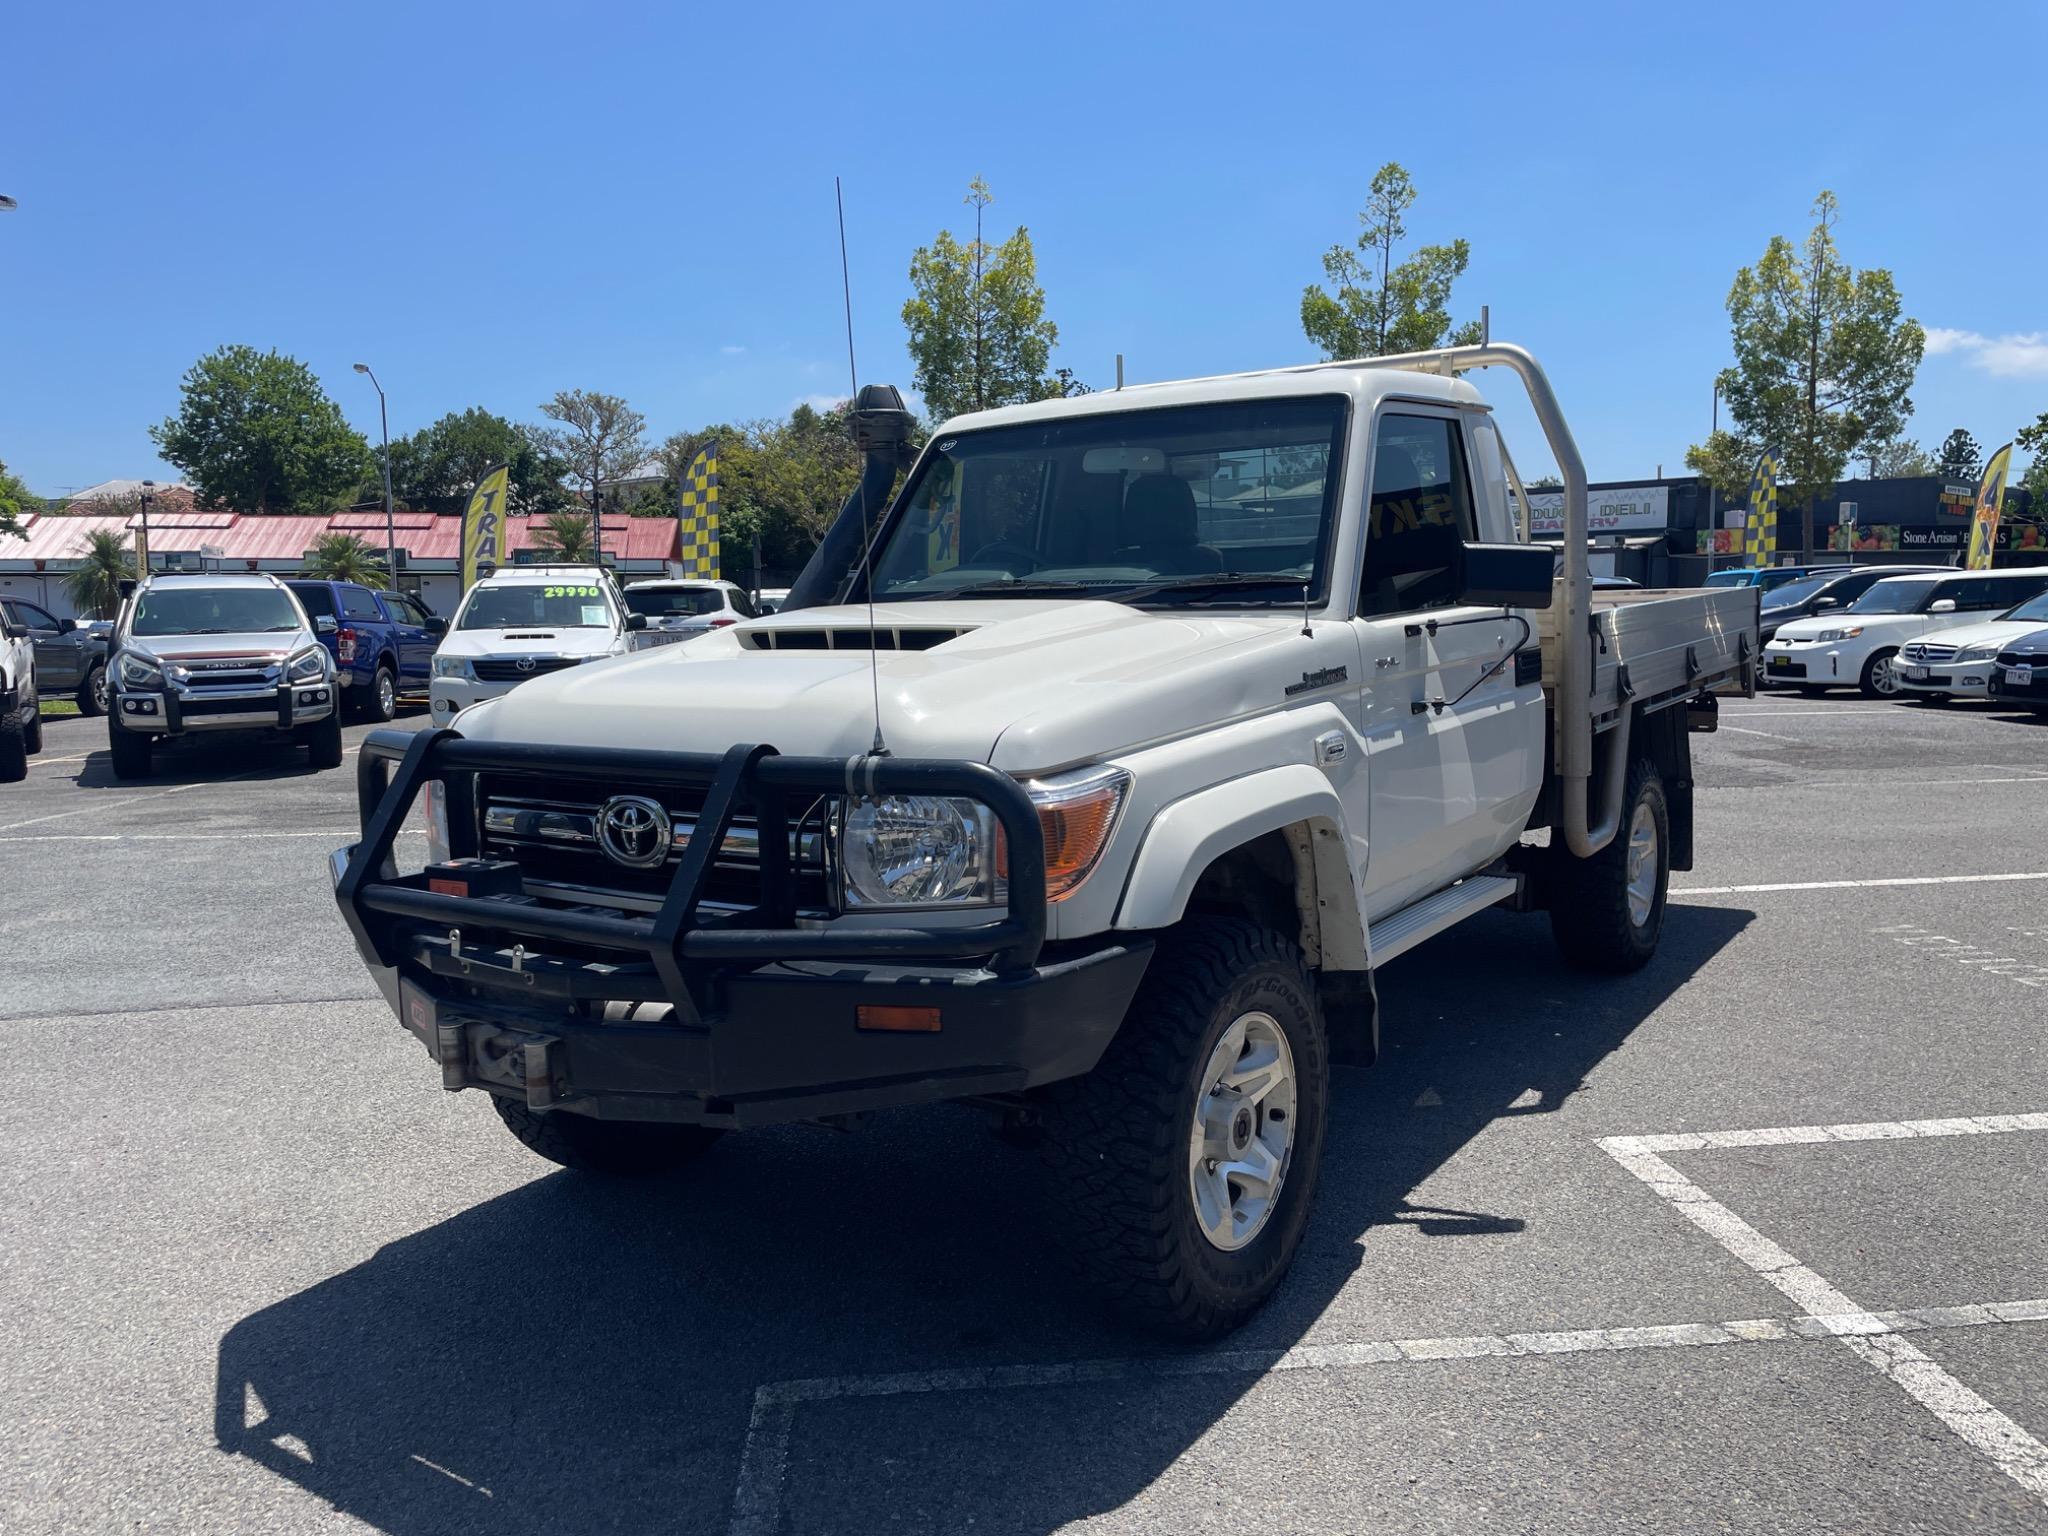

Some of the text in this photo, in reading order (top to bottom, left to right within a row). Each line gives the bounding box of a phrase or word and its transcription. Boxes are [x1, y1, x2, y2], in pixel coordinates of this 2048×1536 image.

[1903, 531, 1926, 544] Stone
[1927, 530, 1957, 544] Artisan
[543, 586, 599, 598] 29990
